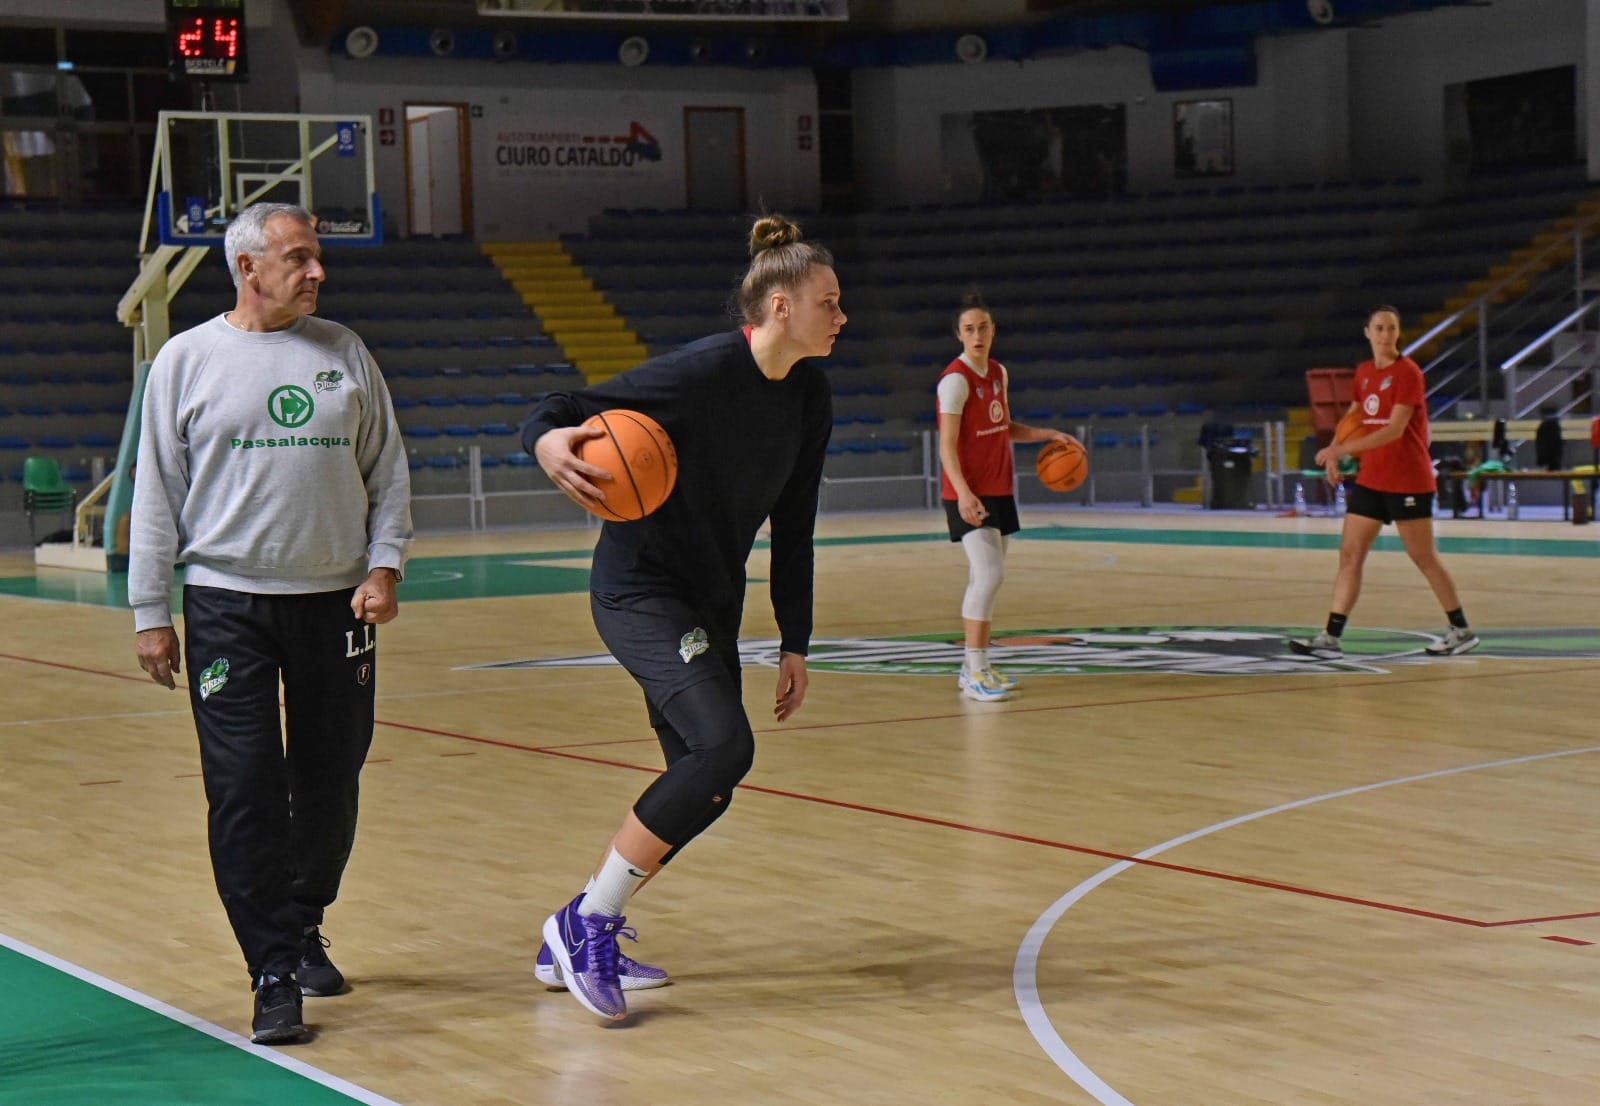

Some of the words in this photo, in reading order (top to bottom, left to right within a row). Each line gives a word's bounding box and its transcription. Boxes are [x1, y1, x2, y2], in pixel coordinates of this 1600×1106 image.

[496, 146, 550, 166] CIURO
[555, 146, 633, 166] CATALDO
[231, 435, 351, 449] Passalacqua
